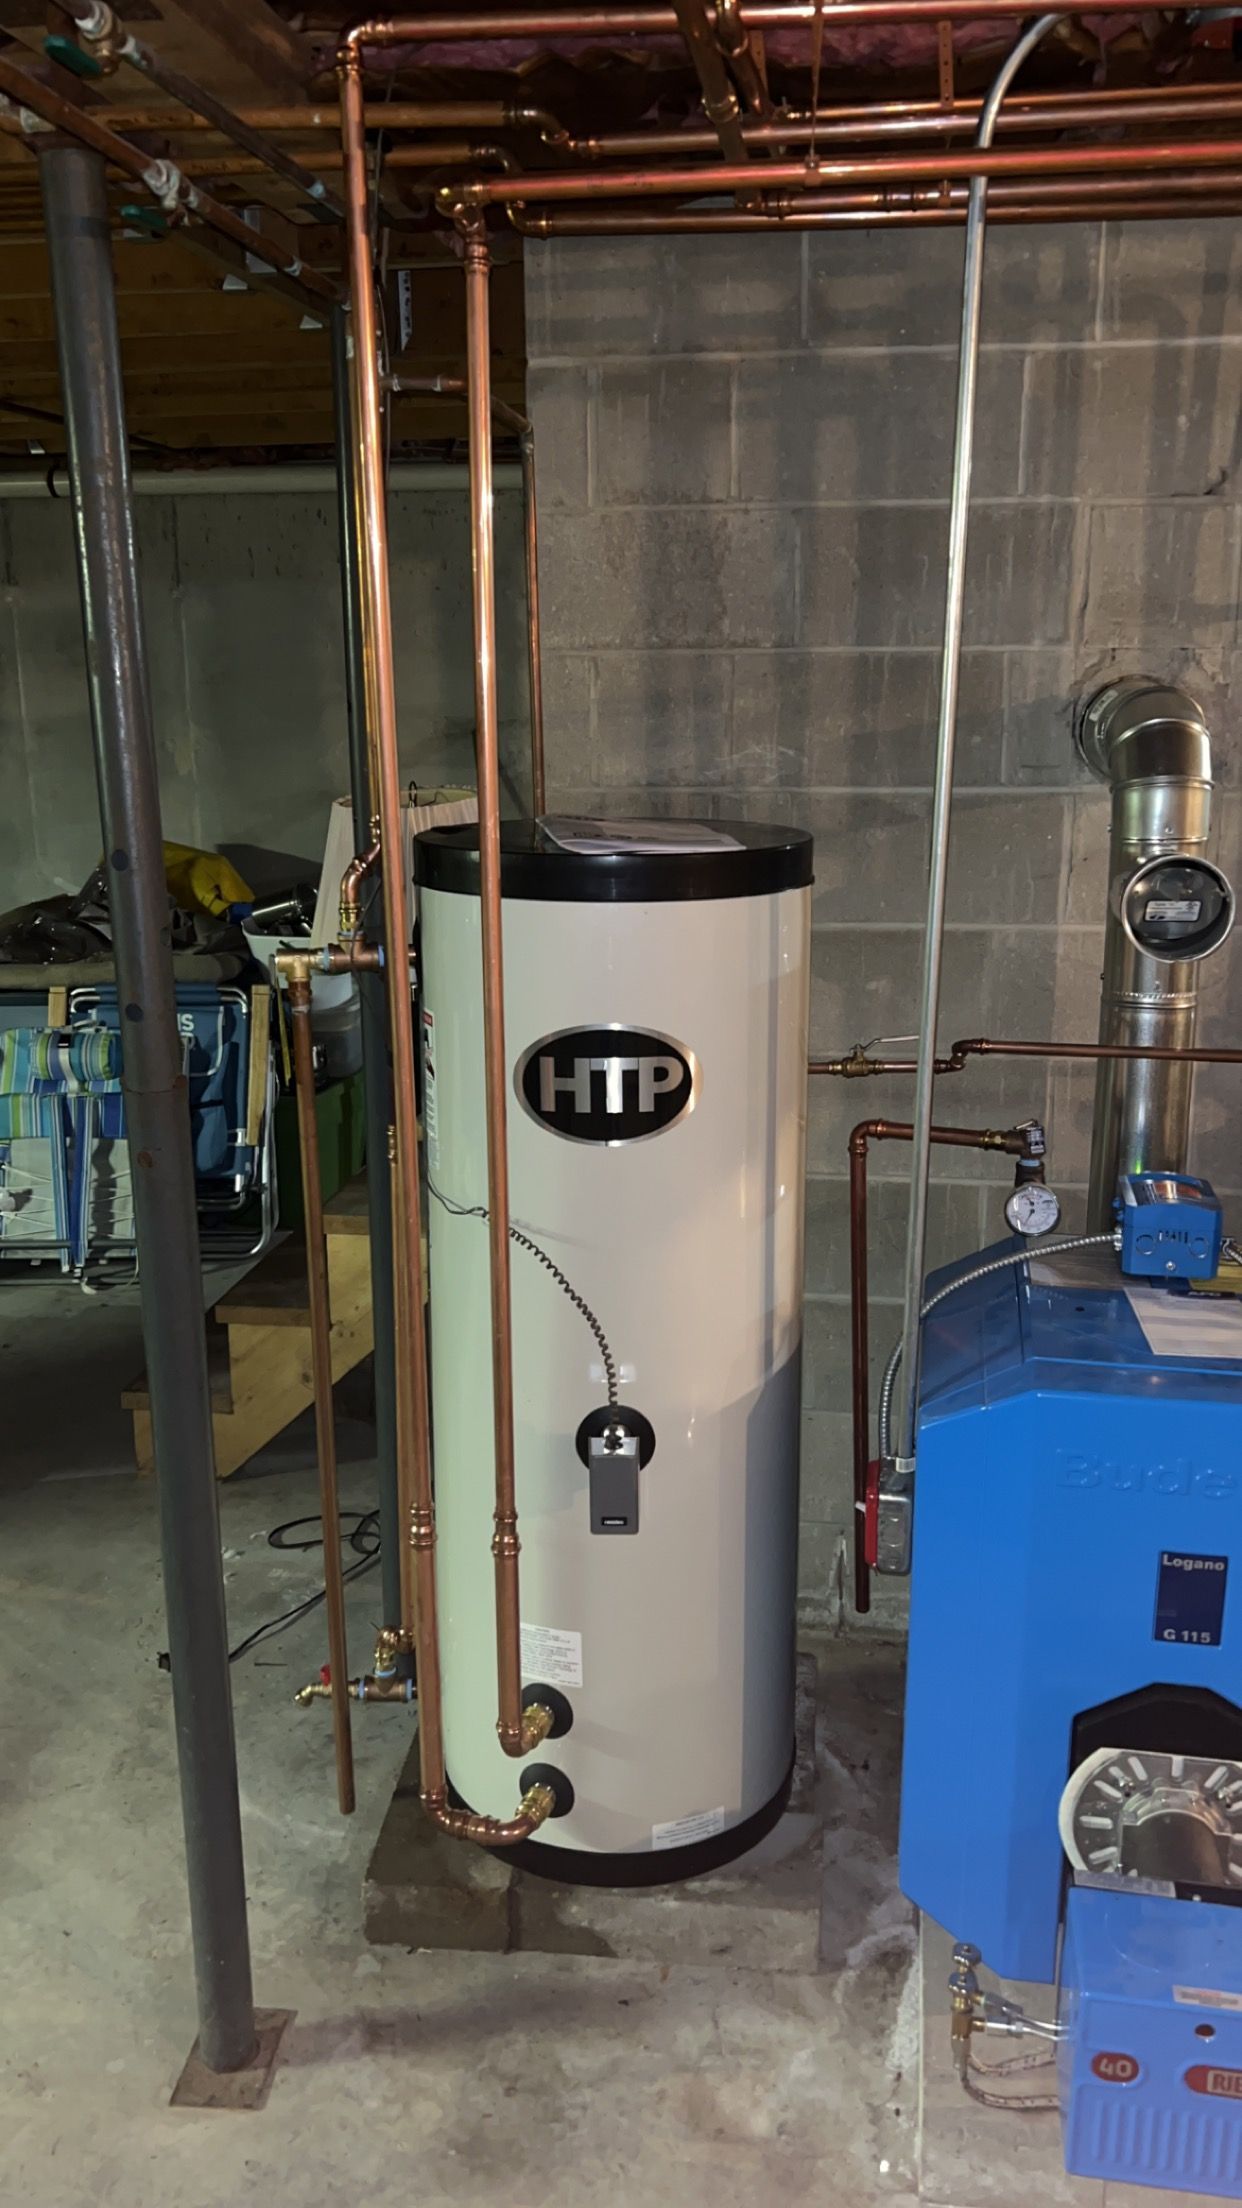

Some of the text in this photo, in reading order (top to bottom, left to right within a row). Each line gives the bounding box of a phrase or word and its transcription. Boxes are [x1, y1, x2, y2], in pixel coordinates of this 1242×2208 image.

[539, 1056, 684, 1113] HTP
[1056, 1449, 1238, 1499] Bude
[1162, 1553, 1225, 1571] Logano
[1163, 1628, 1211, 1643] G 115
[1100, 2057, 1132, 2078] 40
